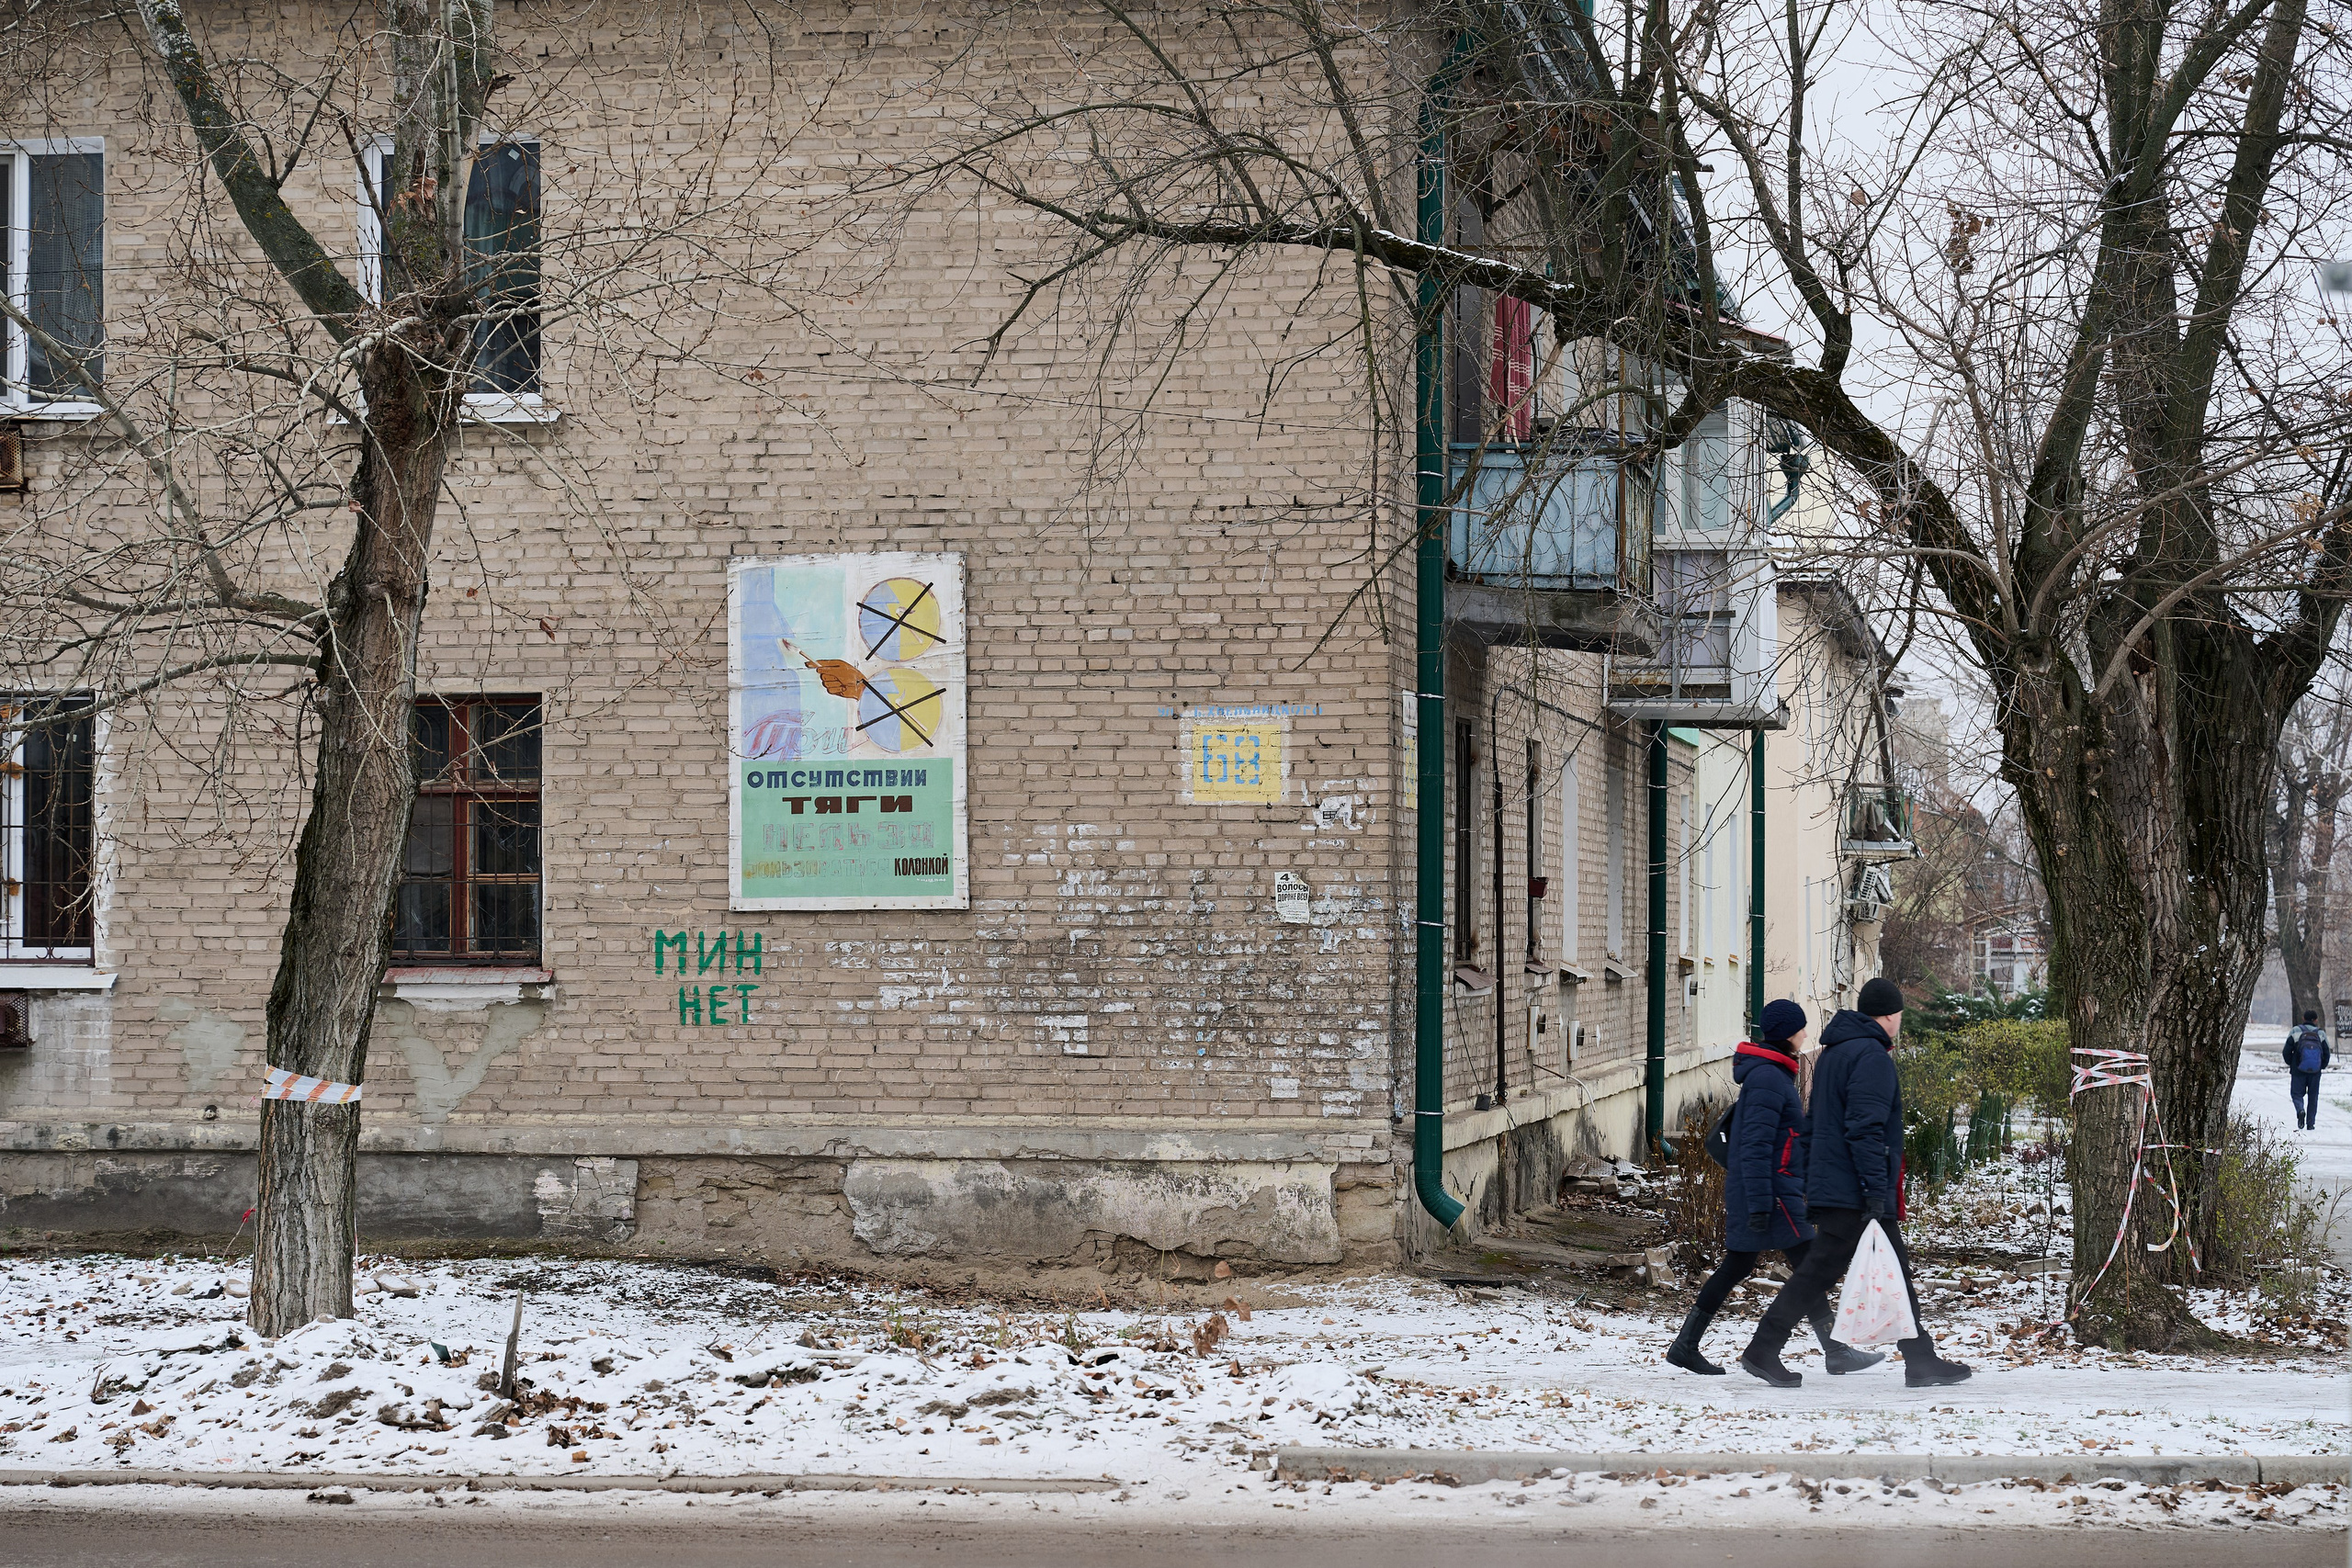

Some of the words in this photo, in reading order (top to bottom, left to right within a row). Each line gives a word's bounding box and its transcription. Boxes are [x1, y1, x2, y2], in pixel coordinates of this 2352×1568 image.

[1203, 735, 1260, 784] 68
[782, 795, 913, 815] ТЯГИ
[763, 821, 935, 852] НЕЛЬЗЯ
[894, 852, 949, 876] КОЛОНКОЙ
[1280, 873, 1290, 882] 4
[1277, 884, 1308, 893] ВОЛОСЫ
[654, 930, 763, 978] МИН
[679, 984, 761, 1026] НЕТ
